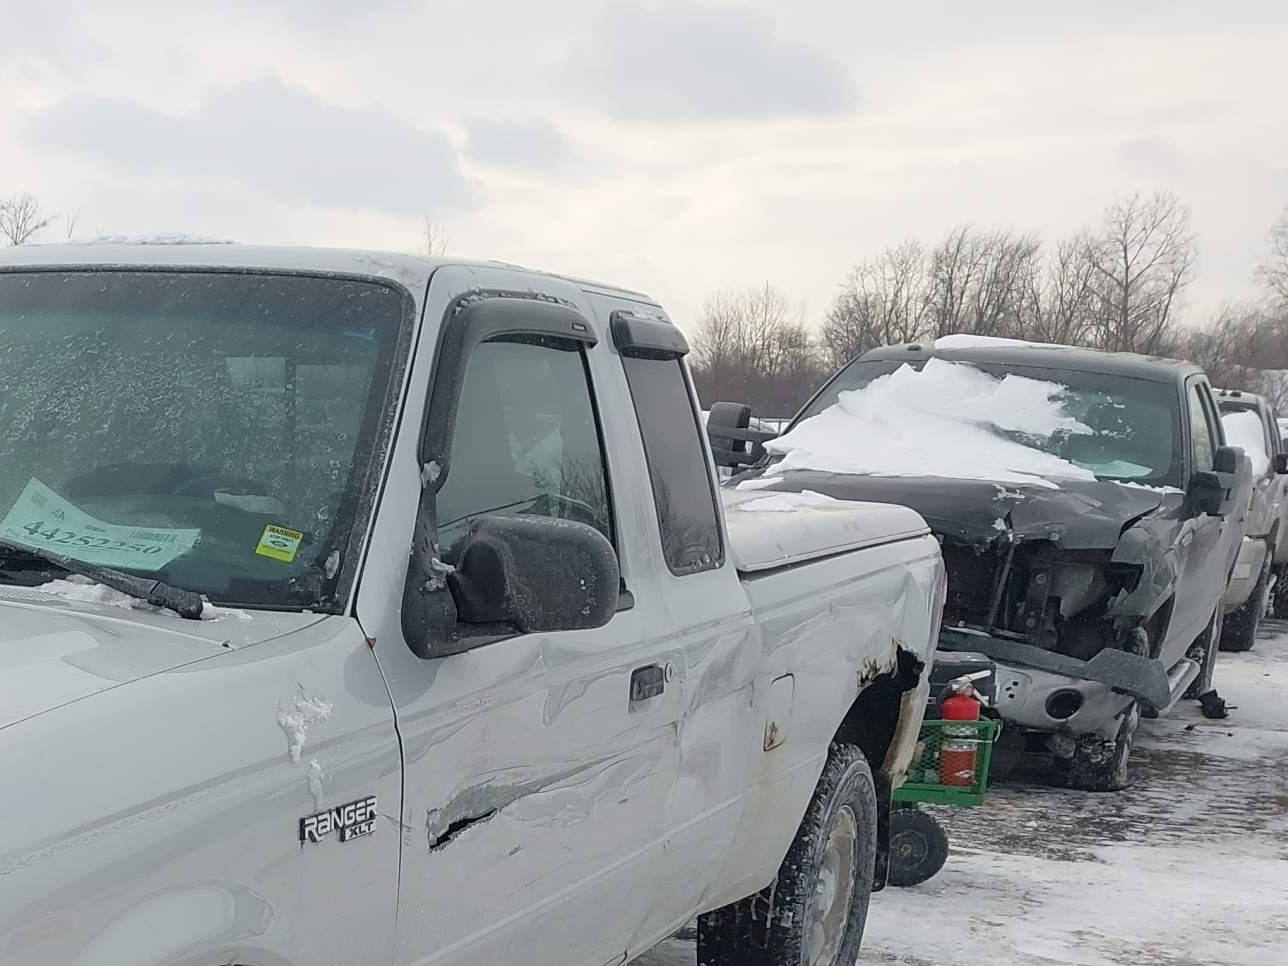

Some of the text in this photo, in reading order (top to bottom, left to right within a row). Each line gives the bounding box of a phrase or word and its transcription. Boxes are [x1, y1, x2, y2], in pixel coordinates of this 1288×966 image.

[22, 520, 163, 555] 44252250
[268, 526, 301, 541] WARNING
[300, 795, 377, 842] RANGER
[345, 820, 376, 840] XLT
